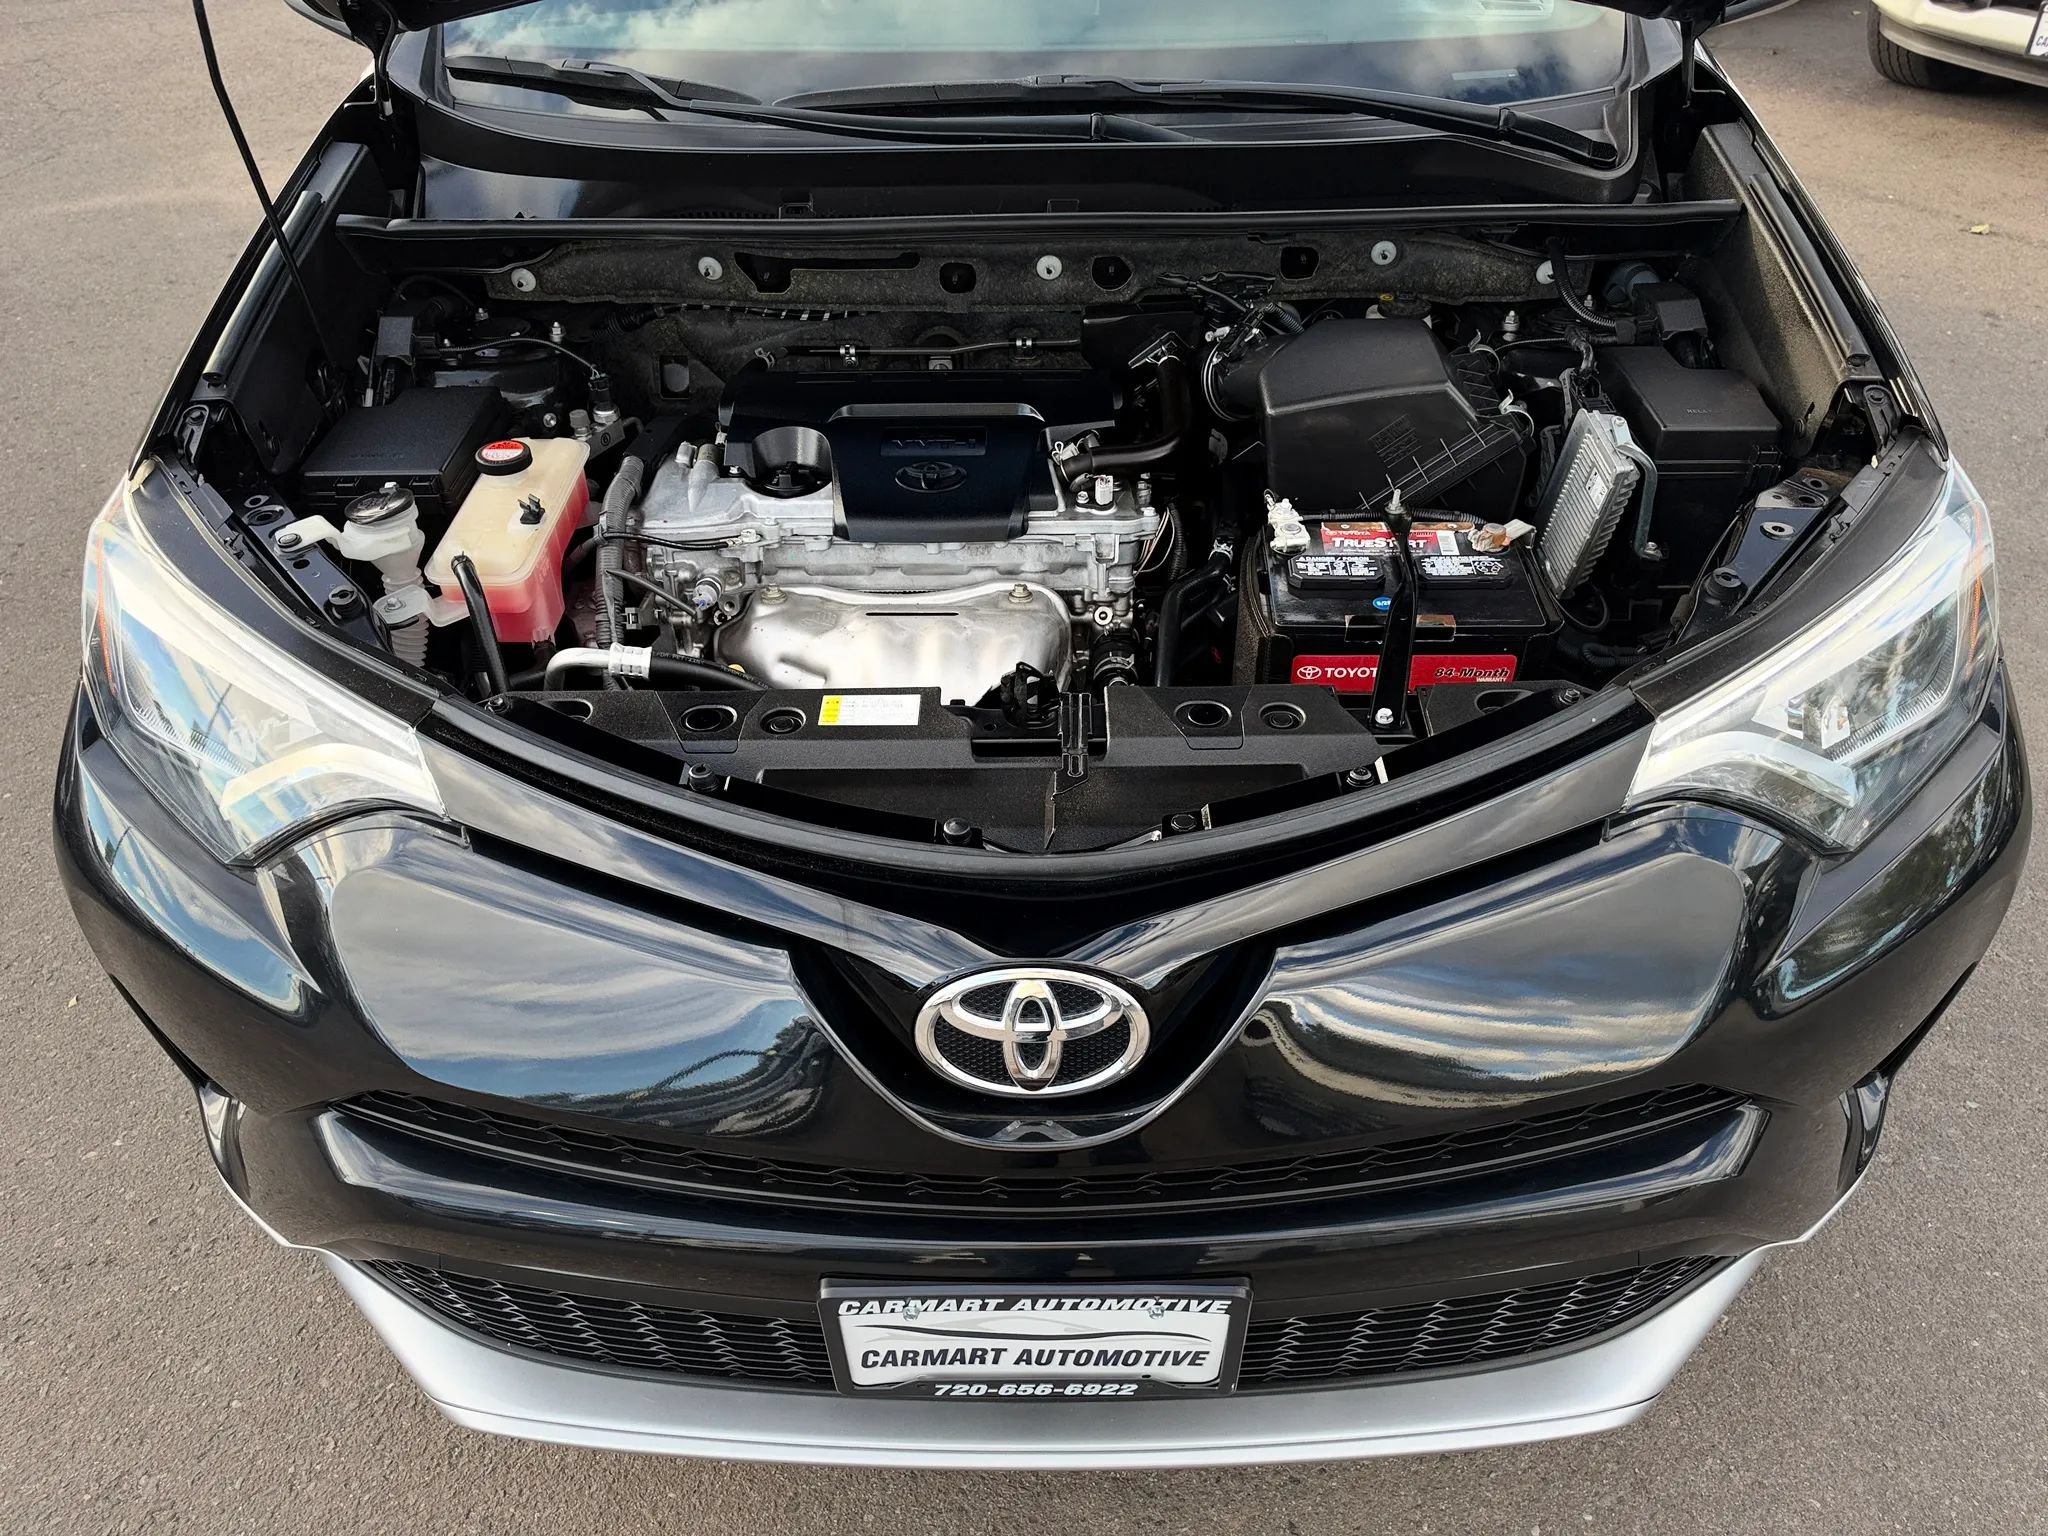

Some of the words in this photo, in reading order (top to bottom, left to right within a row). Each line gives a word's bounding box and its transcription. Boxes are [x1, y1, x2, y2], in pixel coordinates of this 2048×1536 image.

[1332, 537, 1427, 548] TRUESTRT
[1325, 667, 1378, 678] TOYOT
[1435, 667, 1510, 678] 84-Month
[838, 1299, 1004, 1315] CARMART
[1010, 1299, 1232, 1314] AUTOMOTIVE
[861, 1348, 1008, 1369] CARMART
[1013, 1349, 1210, 1367] AUTOMOTIVE
[934, 1383, 1139, 1397] 720-656-6922
